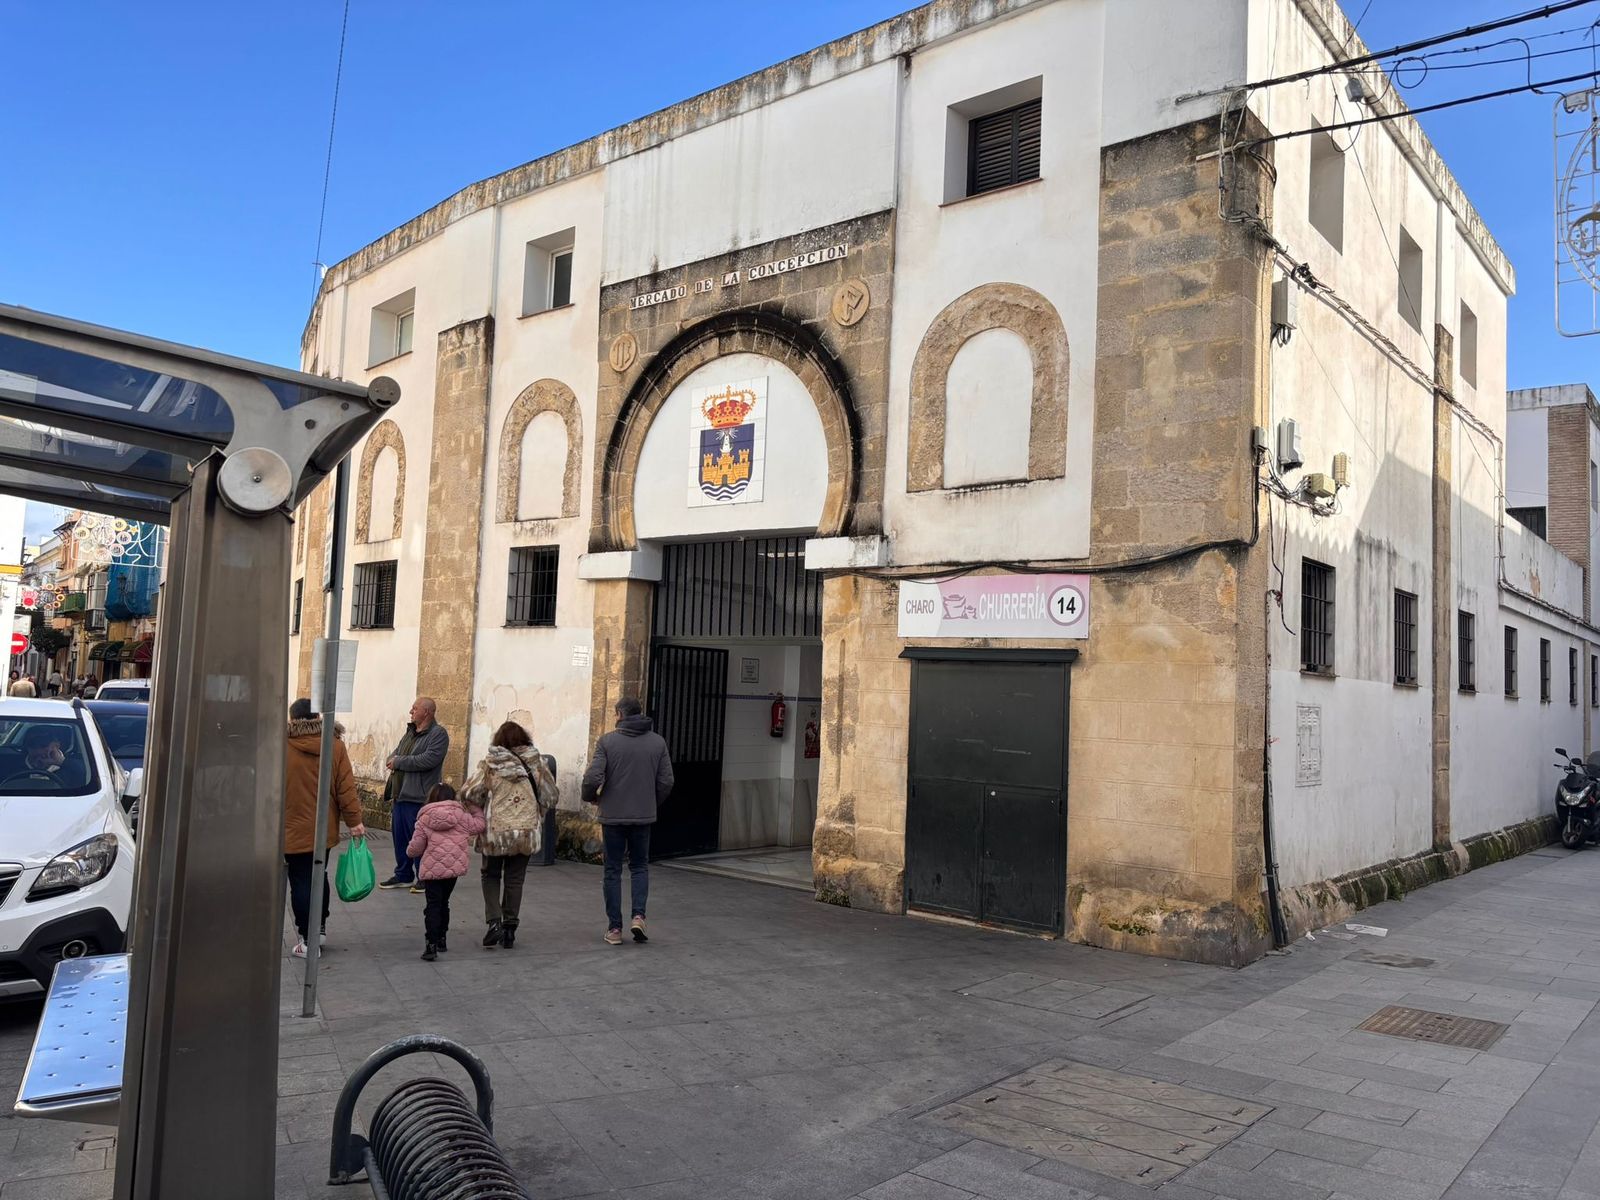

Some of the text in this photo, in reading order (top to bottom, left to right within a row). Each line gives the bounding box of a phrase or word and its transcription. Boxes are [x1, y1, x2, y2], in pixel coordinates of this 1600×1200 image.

[630, 244, 847, 308] MERCADO DE LA CONCEPCION
[905, 586, 1076, 620] CHARO CHURRERÍA 14
